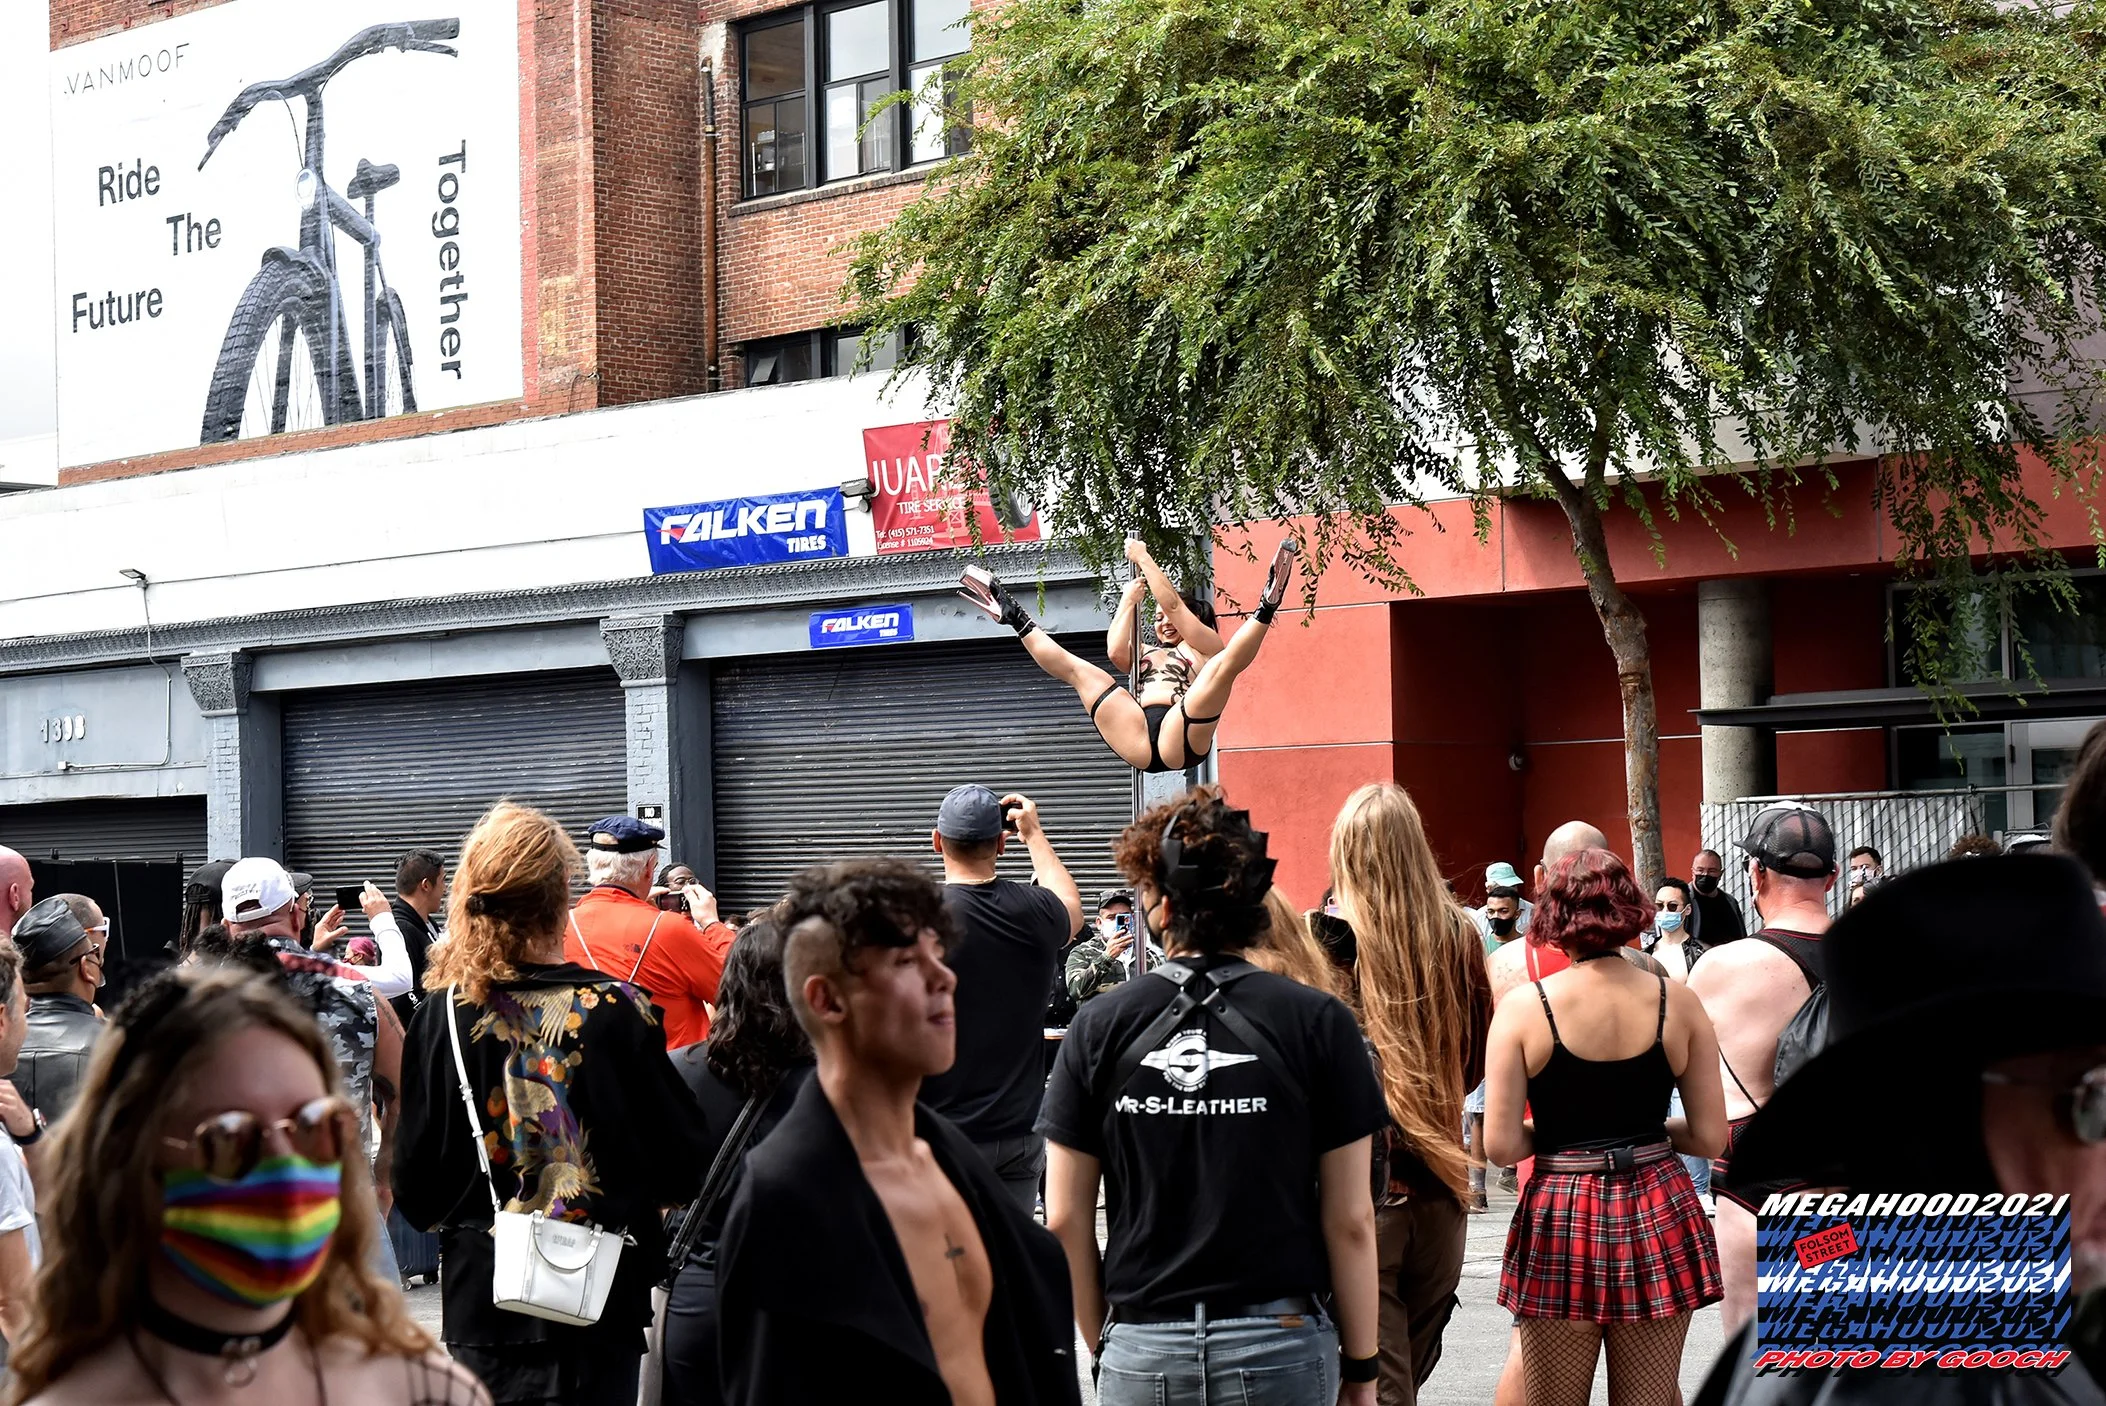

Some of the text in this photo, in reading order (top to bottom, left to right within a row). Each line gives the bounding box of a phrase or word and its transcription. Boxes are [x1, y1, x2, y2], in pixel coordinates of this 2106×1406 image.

[66, 42, 189, 95] VANMOOF
[98, 158, 161, 206] Ride
[166, 212, 222, 256] The
[431, 139, 469, 381] Together
[71, 287, 163, 333] Future
[657, 499, 828, 545] FALKEN
[896, 500, 921, 515] TIRE
[787, 535, 827, 554] TIRES
[821, 612, 900, 634] FALKEN
